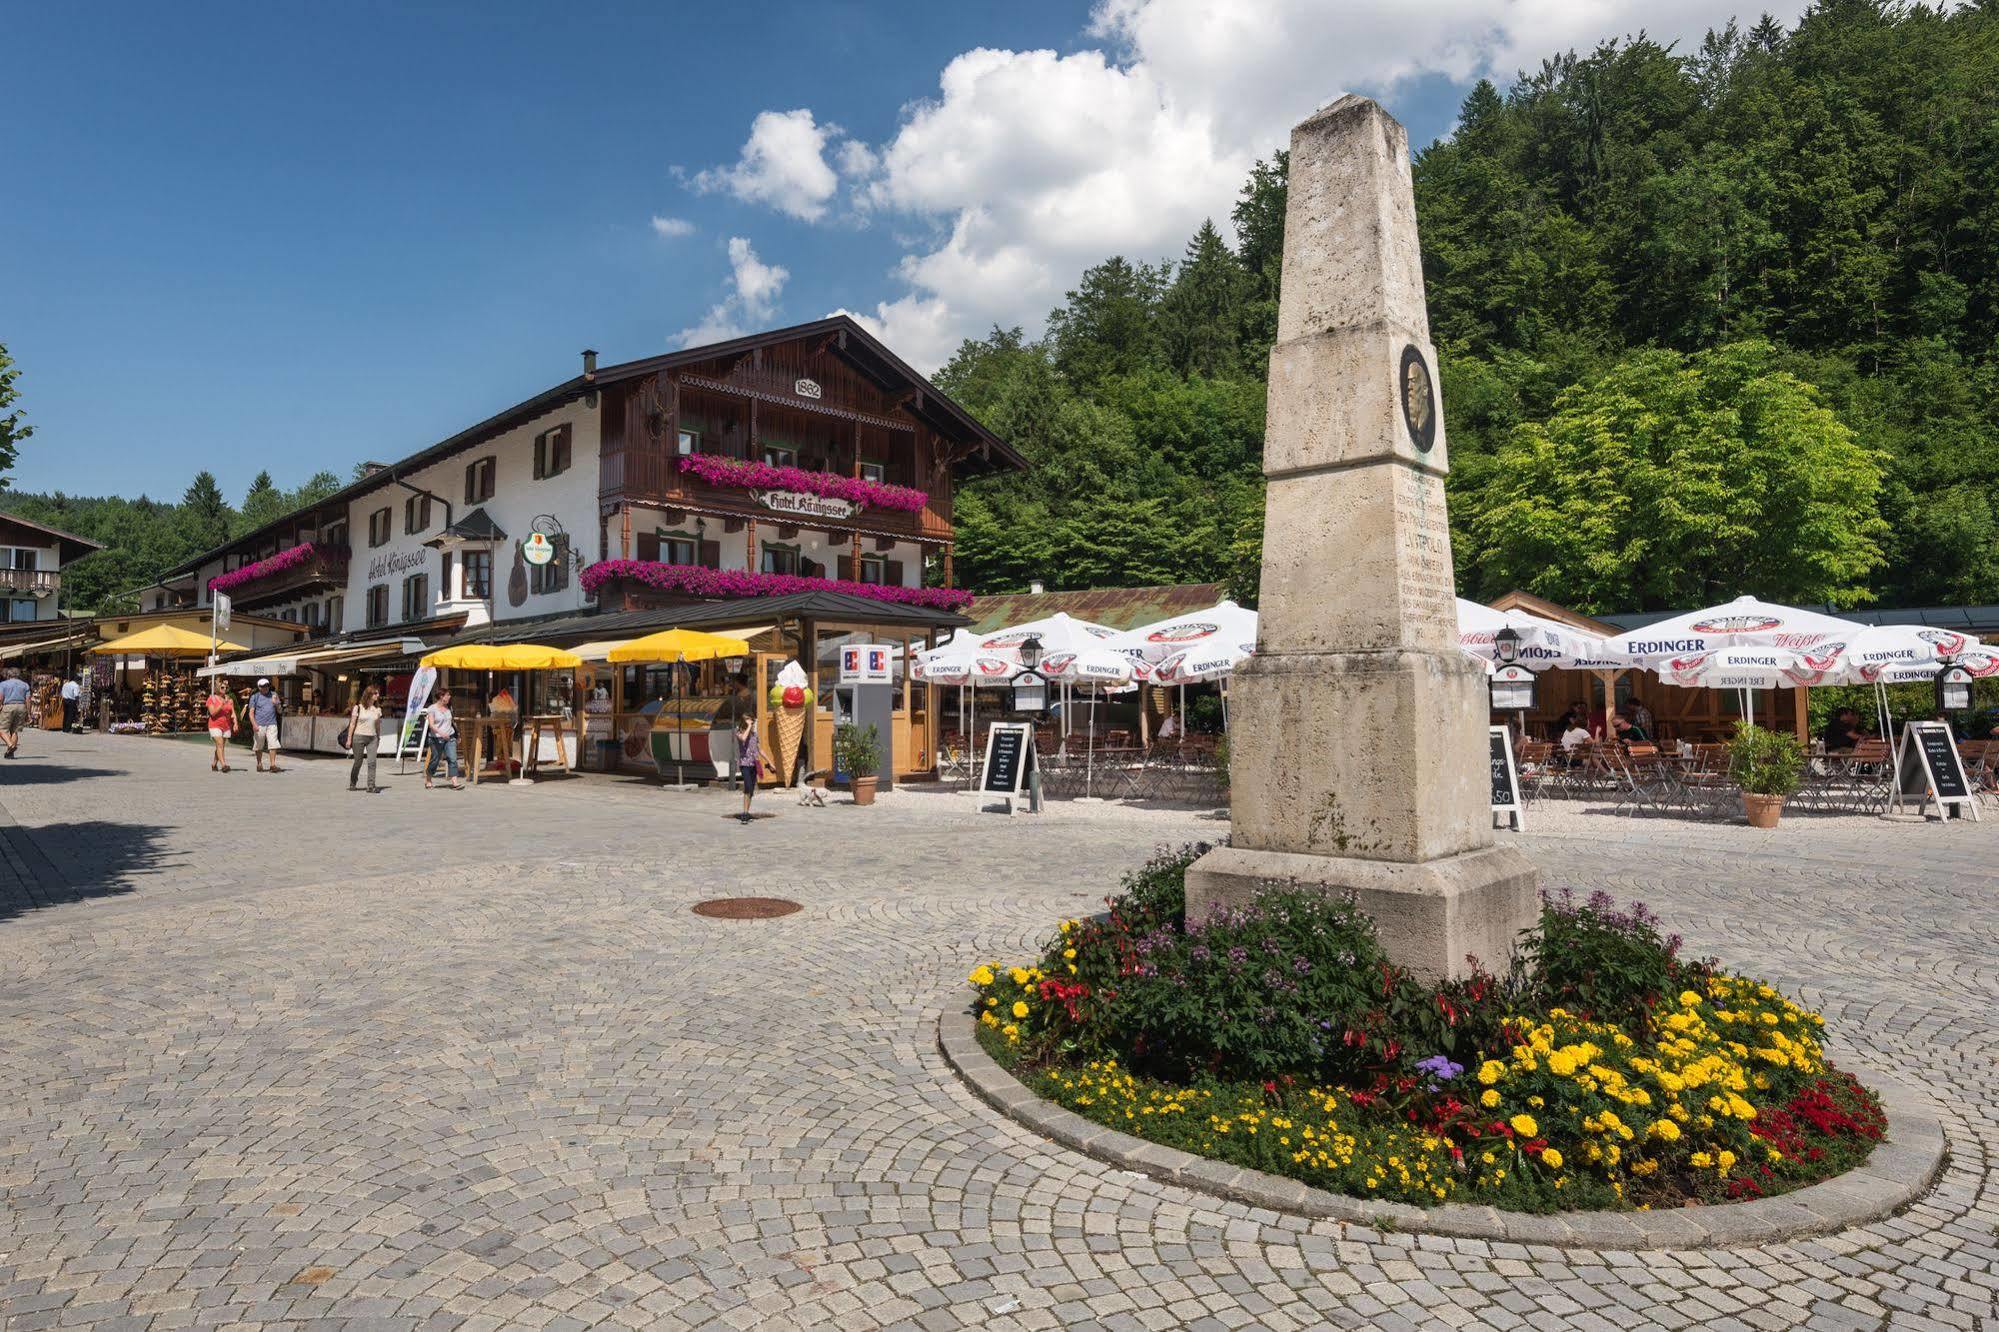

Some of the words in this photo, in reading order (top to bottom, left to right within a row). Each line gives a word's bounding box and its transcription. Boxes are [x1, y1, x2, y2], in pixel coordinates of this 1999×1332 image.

[797, 381, 820, 397] 1862
[770, 493, 796, 510] Hotel
[368, 554, 387, 582] Hotel
[388, 549, 427, 576] Königssee
[1628, 639, 1705, 654] ERDINGER
[1727, 656, 1777, 666] ERDINGER
[1863, 649, 1914, 661] ERDINGER
[932, 666, 961, 674] ERDINGER
[1086, 664, 1120, 676] ERDINGER
[1193, 659, 1231, 673] ERDINGER
[1893, 670, 1936, 680] ERDINGER
